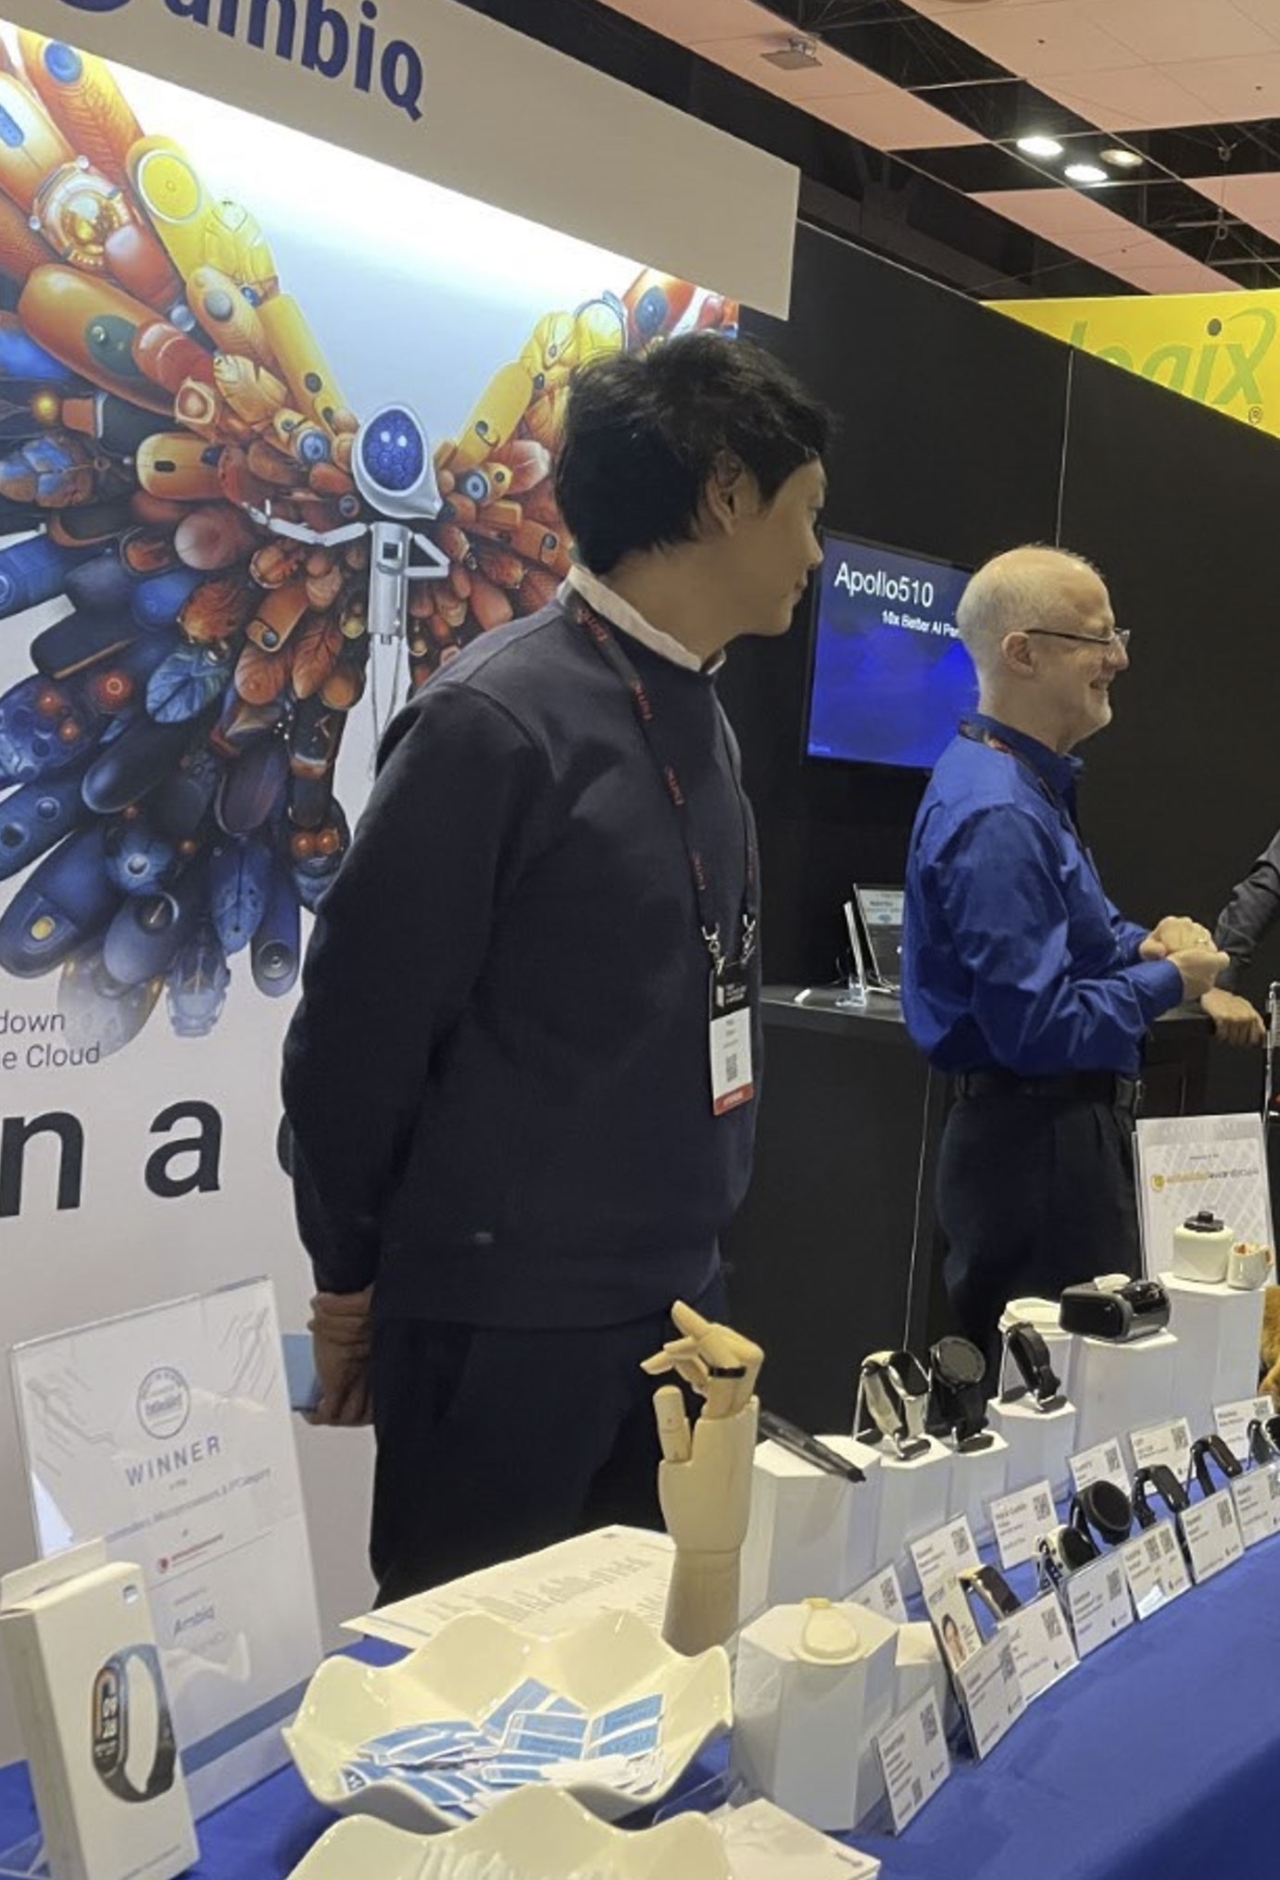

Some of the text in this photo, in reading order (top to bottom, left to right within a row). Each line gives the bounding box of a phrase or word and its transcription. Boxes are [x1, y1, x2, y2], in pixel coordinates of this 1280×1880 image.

[834, 561, 934, 608] Apollo510
[901, 613, 930, 633] Better
[931, 620, 942, 635] AI
[26, 1041, 101, 1069] Cloud
[126, 1435, 221, 1487] WINNER
